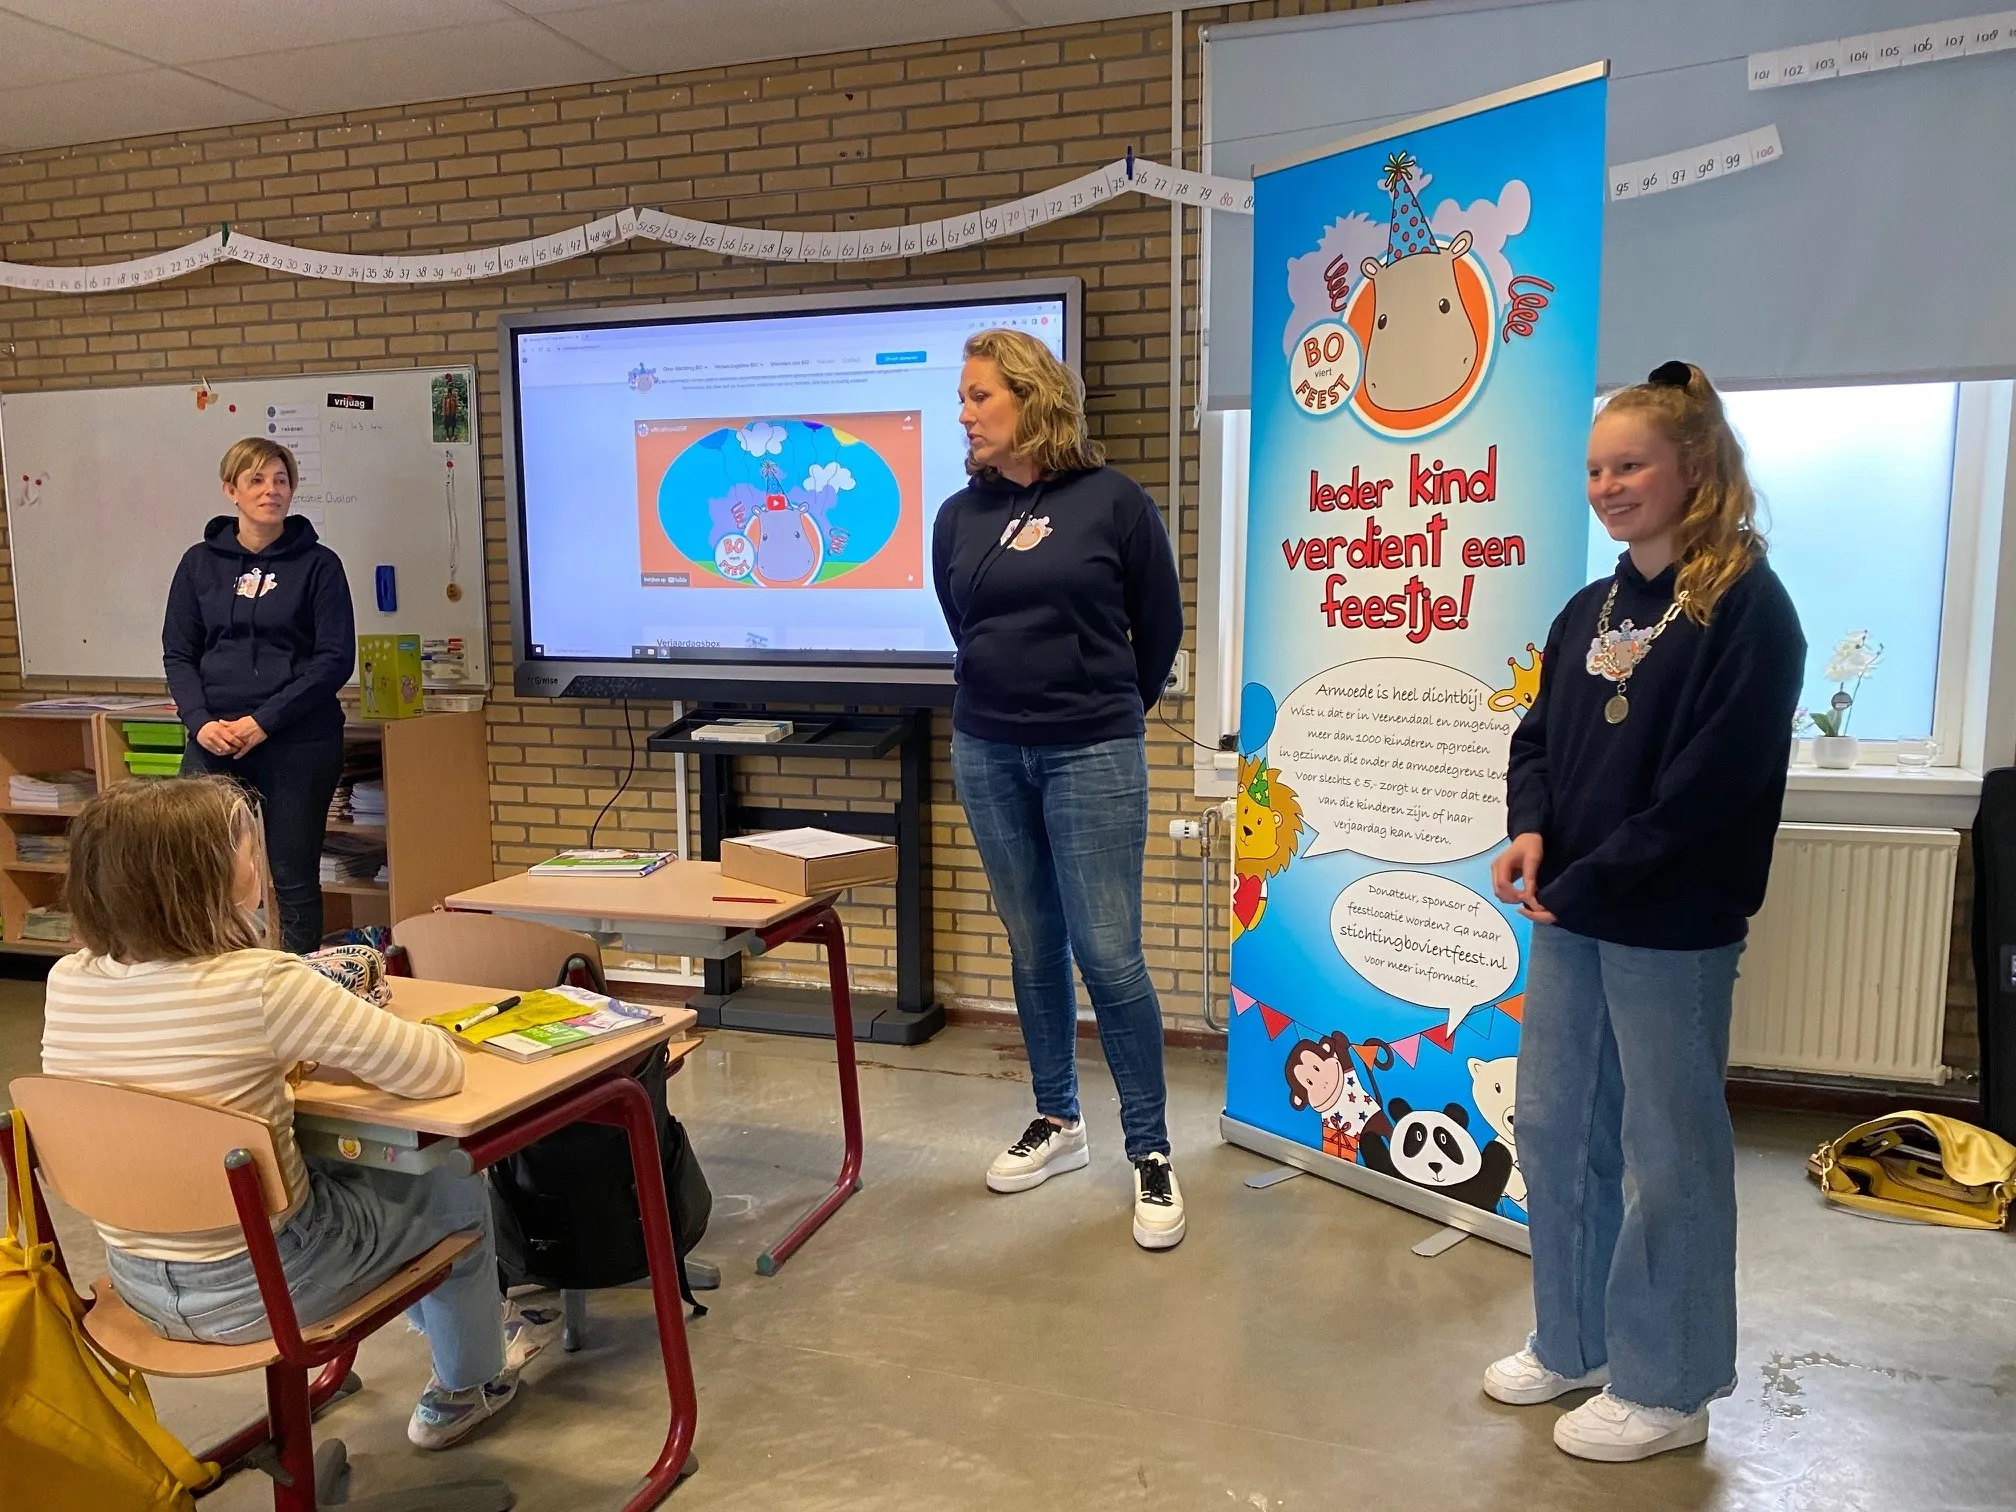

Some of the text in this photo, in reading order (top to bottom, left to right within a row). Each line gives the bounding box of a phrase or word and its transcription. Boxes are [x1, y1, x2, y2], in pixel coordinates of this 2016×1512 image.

[1754, 70, 1770, 80] 101
[1783, 65, 1803, 78] 102
[1815, 57, 1835, 70] 103
[1850, 51, 1869, 63] 104
[1880, 45, 1901, 58] 105
[1912, 37, 1933, 54] 106
[1945, 35, 1965, 47] 107
[1976, 29, 1998, 42] 108
[1616, 145, 1774, 196] 95 96 97 98 99 100
[89, 276, 97, 288] 16
[157, 267, 164, 277] 21
[171, 261, 181, 273] 22
[185, 257, 196, 269] 23
[198, 253, 209, 263] 24
[227, 245, 238, 257] 26
[243, 249, 254, 261] 27
[258, 253, 270, 264] 28
[271, 257, 283, 268] 29
[286, 258, 298, 269] 30
[303, 262, 311, 273] 31
[316, 264, 327, 275] 32
[331, 265, 343, 276] 33
[349, 267, 359, 278] 34
[366, 268, 377, 279] 35
[383, 267, 394, 278] 36
[400, 268, 410, 280] 37
[416, 266, 427, 277] 38
[433, 268, 443, 279] 39
[451, 267, 462, 277] 40
[466, 262, 476, 274] 41
[484, 260, 495, 271] 42
[503, 259, 513, 269] 43
[518, 255, 529, 266] 44
[536, 250, 546, 261] 45
[552, 243, 563, 256] 46
[571, 239, 581, 251] 47
[590, 231, 600, 243] 48
[602, 230, 611, 241] 49
[622, 222, 634, 235] 50
[637, 221, 647, 231] 51
[648, 224, 661, 234] 52
[665, 228, 678, 238] 53
[684, 232, 696, 242] 54
[702, 236, 716, 246] 55
[722, 238, 736, 249] 56
[741, 242, 754, 252] 57
[761, 243, 775, 253] 58
[782, 246, 793, 256] 59
[803, 244, 815, 256] 60
[822, 244, 831, 256] 61
[842, 244, 854, 256] 62
[863, 243, 874, 255] 63
[880, 240, 892, 252] 64
[904, 239, 915, 250] 65
[925, 233, 938, 247] 66
[947, 229, 959, 243] 67
[962, 222, 976, 237] 68
[985, 216, 998, 234] 69
[1006, 210, 1020, 226] 70
[1028, 208, 1039, 222] 71
[1050, 200, 1062, 215] 72
[1069, 193, 1083, 208] 73
[1091, 185, 1103, 198] 74
[1112, 177, 1125, 192] 75
[1135, 172, 1148, 186] 76
[1153, 178, 1167, 191] 77
[1175, 183, 1189, 195] 78
[1200, 186, 1213, 200] 79
[1220, 192, 1233, 206] 80
[1304, 332, 1344, 369] BO
[1314, 367, 1333, 378] viert
[334, 398, 365, 409] vrijdag
[1295, 374, 1350, 410] FEEST
[1309, 444, 1498, 513] Ieder kind
[723, 538, 745, 554] BO
[1281, 512, 1526, 571] verdient een
[719, 559, 750, 576] FEEST
[1320, 573, 1476, 644] feestje!
[1315, 683, 1483, 712] Armoede is heel dichtbij!
[1290, 705, 1315, 717] Wist
[1327, 708, 1344, 719] dat
[1345, 711, 1355, 720] er
[1357, 709, 1369, 721] in
[1436, 718, 1451, 727] en
[1453, 719, 1510, 735] omgeving
[1307, 729, 1490, 755] meer dan 1000 kinderen opgroeien
[1279, 746, 1508, 781] in gezinnen die onder de armoedegrens leve
[1319, 773, 1352, 787] slechts
[1354, 778, 1360, 787] €
[1379, 781, 1409, 795] zorgt
[1411, 786, 1419, 794] u
[1421, 786, 1433, 796] er
[1434, 788, 1459, 799] voor
[1461, 789, 1480, 801] dat
[1482, 794, 1501, 803] een
[1318, 796, 1473, 824] van die kinderen zijn of haar
[1334, 819, 1451, 845] verjaardag kan vieren.
[1368, 884, 1481, 917] Donateur, sponsor of
[1347, 901, 1501, 942] feestlocatie worden? Ga naar
[1340, 922, 1508, 971] stichtingboviertfeest.nl
[1364, 955, 1478, 988] voor meer informatie.
